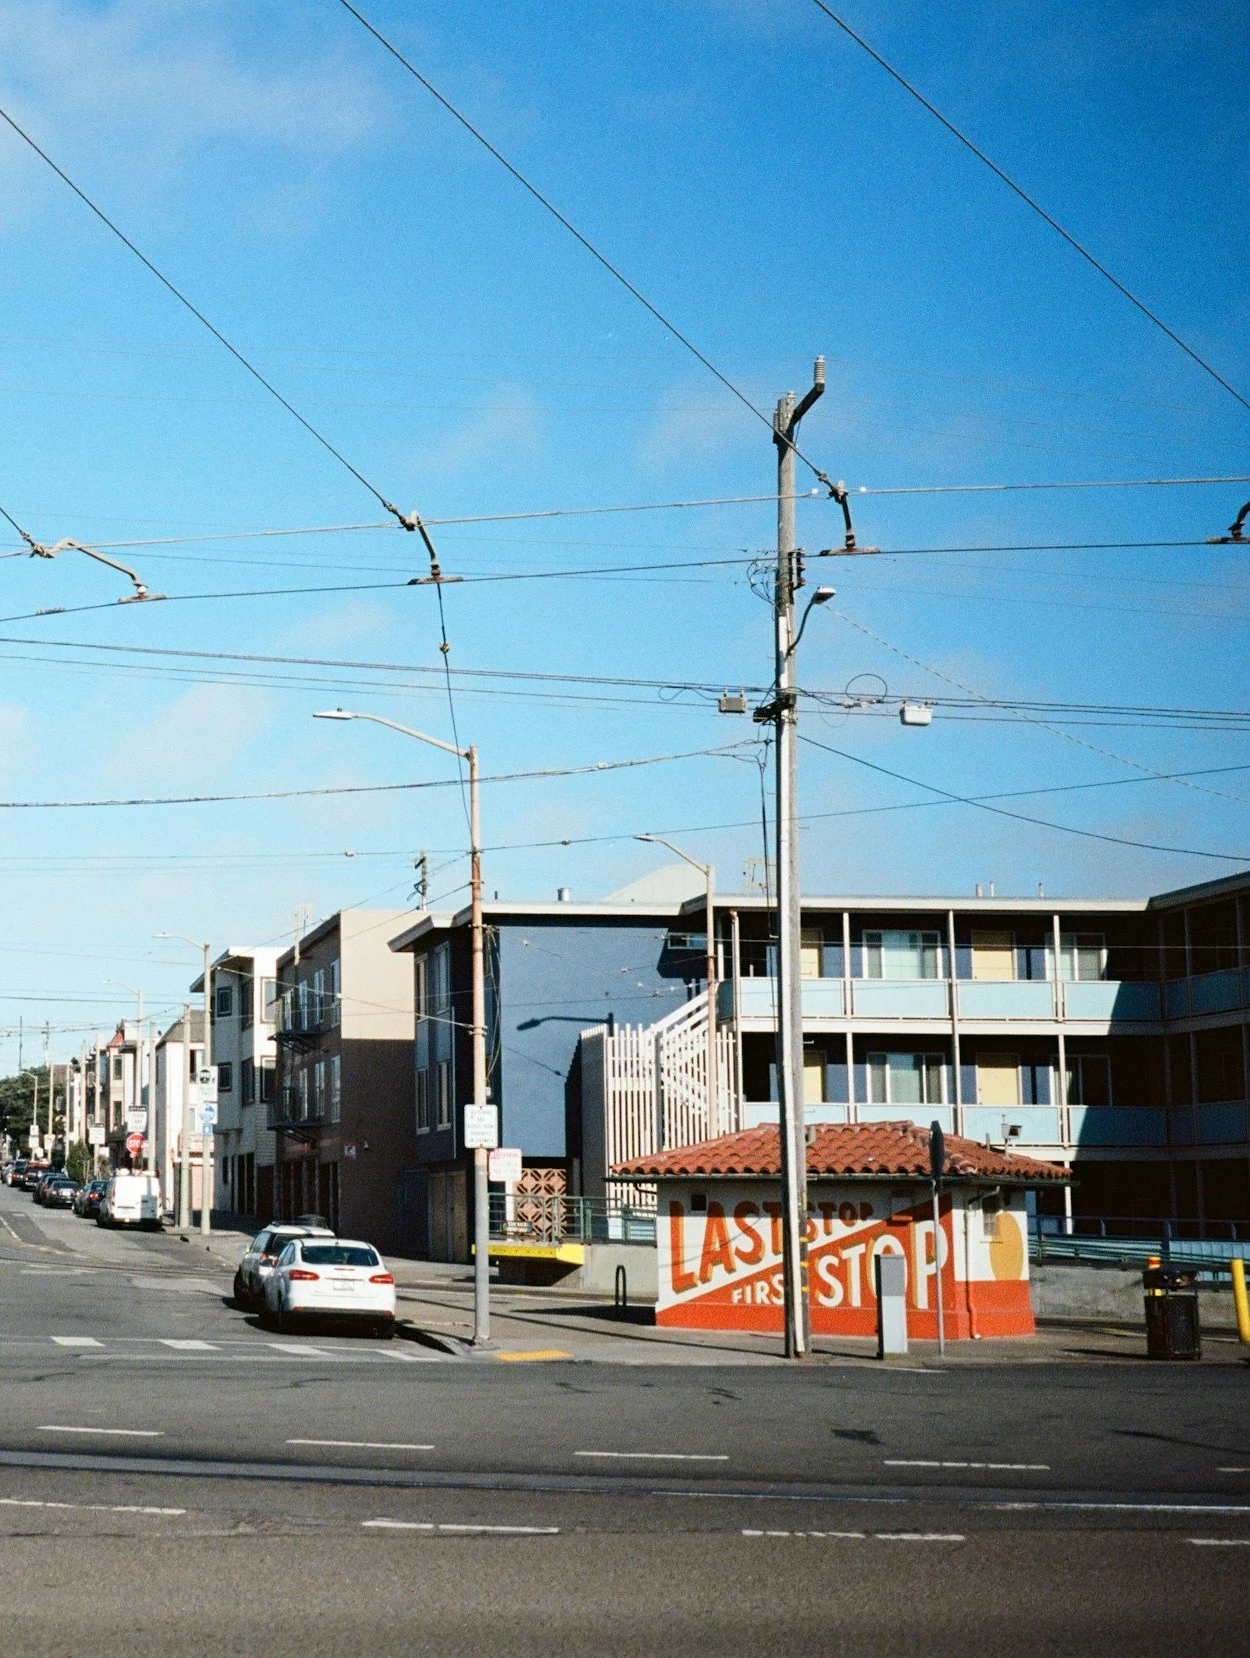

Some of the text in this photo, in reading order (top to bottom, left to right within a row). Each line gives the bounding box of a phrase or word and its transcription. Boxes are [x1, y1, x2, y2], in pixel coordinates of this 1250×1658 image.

[669, 1199, 784, 1294] LAST
[732, 1220, 948, 1310] FIRS STOP
